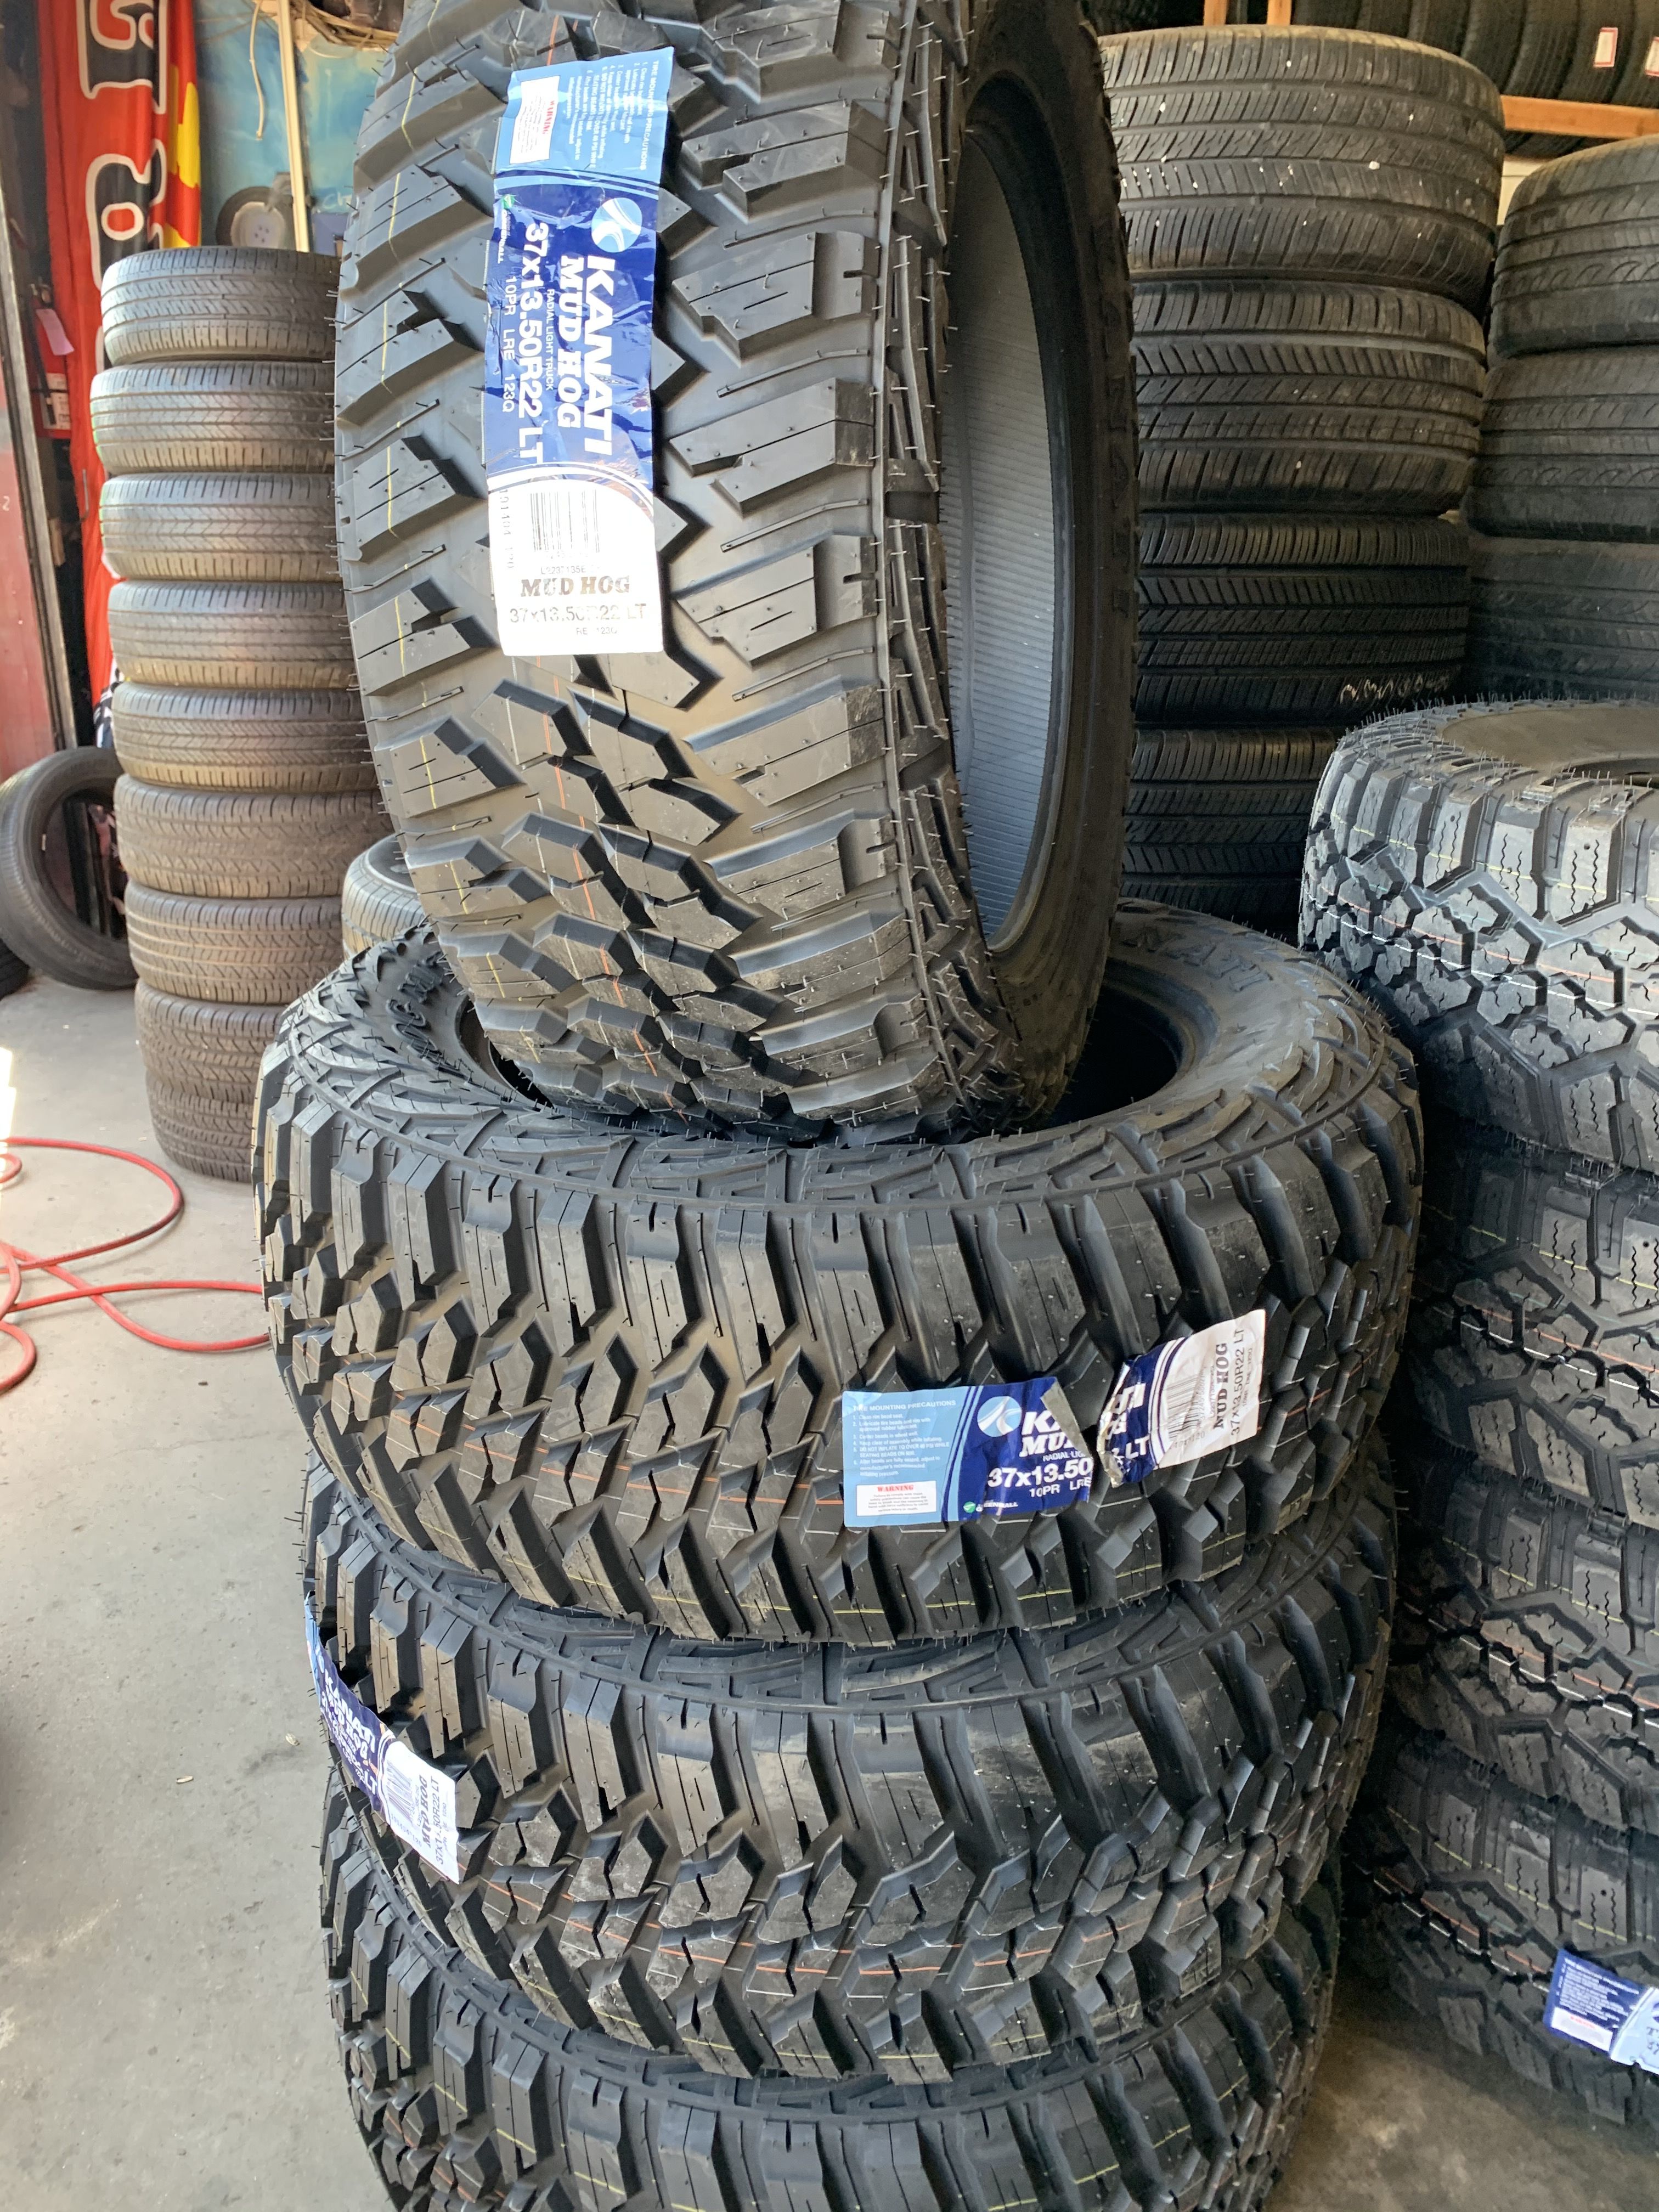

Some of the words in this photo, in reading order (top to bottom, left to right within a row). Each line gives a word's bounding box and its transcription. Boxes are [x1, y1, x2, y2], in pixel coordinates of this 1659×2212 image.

[593, 120, 601, 134] OVER
[640, 117, 653, 170] PRECAUTIONS
[505, 276, 517, 315] 10PR
[546, 289, 555, 324] RADIAL
[558, 256, 585, 342] MUD
[518, 222, 549, 418] 37x13.50R22
[503, 329, 515, 360] LRE
[545, 326, 554, 355] LIGHT
[584, 255, 616, 456] KANATI
[545, 356, 554, 391] TRUCK
[557, 348, 582, 428] HOG
[503, 374, 515, 412] 123Q
[519, 427, 543, 465] LT
[521, 578, 574, 597] MUD
[580, 575, 629, 594] HOG
[627, 603, 646, 619] LT
[1233, 1329, 1244, 1344] LT
[1215, 1342, 1229, 1384] HOG
[908, 1400, 956, 1409] PRECAUTIONS
[1042, 1451, 1070, 1462] RADIAL
[1125, 1435, 1150, 1459] LT
[1029, 1484, 1060, 1497] 10PR
[1069, 1476, 1092, 1491] LRE
[325, 1669, 375, 1753] KANATI
[346, 1720, 368, 1760] HOG
[364, 1770, 378, 1795] LT
[419, 1774, 429, 1812] HOG
[431, 1775, 439, 1792] LT
